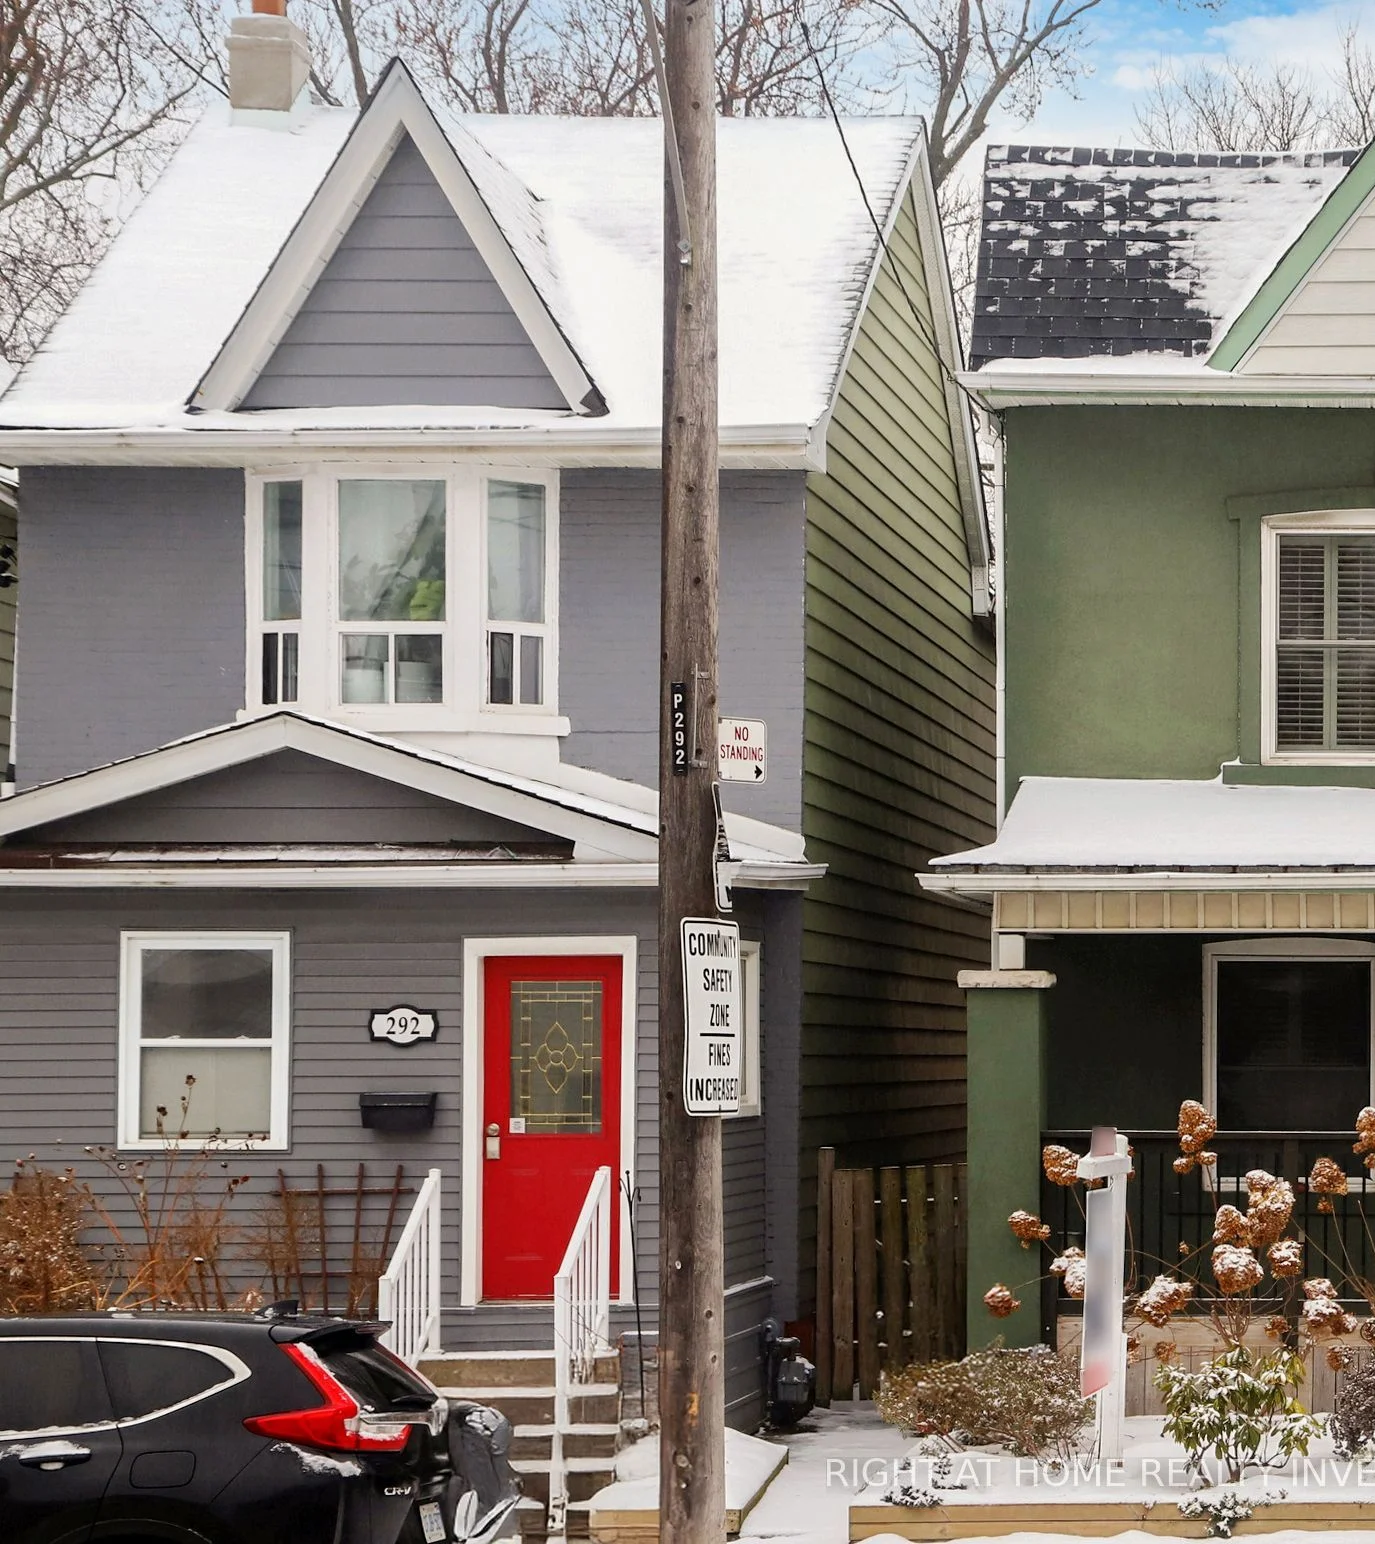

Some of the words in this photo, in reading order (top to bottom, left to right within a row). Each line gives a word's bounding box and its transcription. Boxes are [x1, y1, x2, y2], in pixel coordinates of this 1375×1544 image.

[673, 693, 685, 765] P292
[734, 726, 749, 741] NO
[720, 744, 764, 761] STANDING
[689, 932, 737, 958] COMMUNITY
[703, 967, 732, 992] SAFETY
[386, 1016, 420, 1035] 292
[710, 1003, 730, 1027] ZONE
[709, 1043, 731, 1067] FINES
[689, 1078, 738, 1101] INCREASED
[384, 1486, 412, 1496] CR-V
